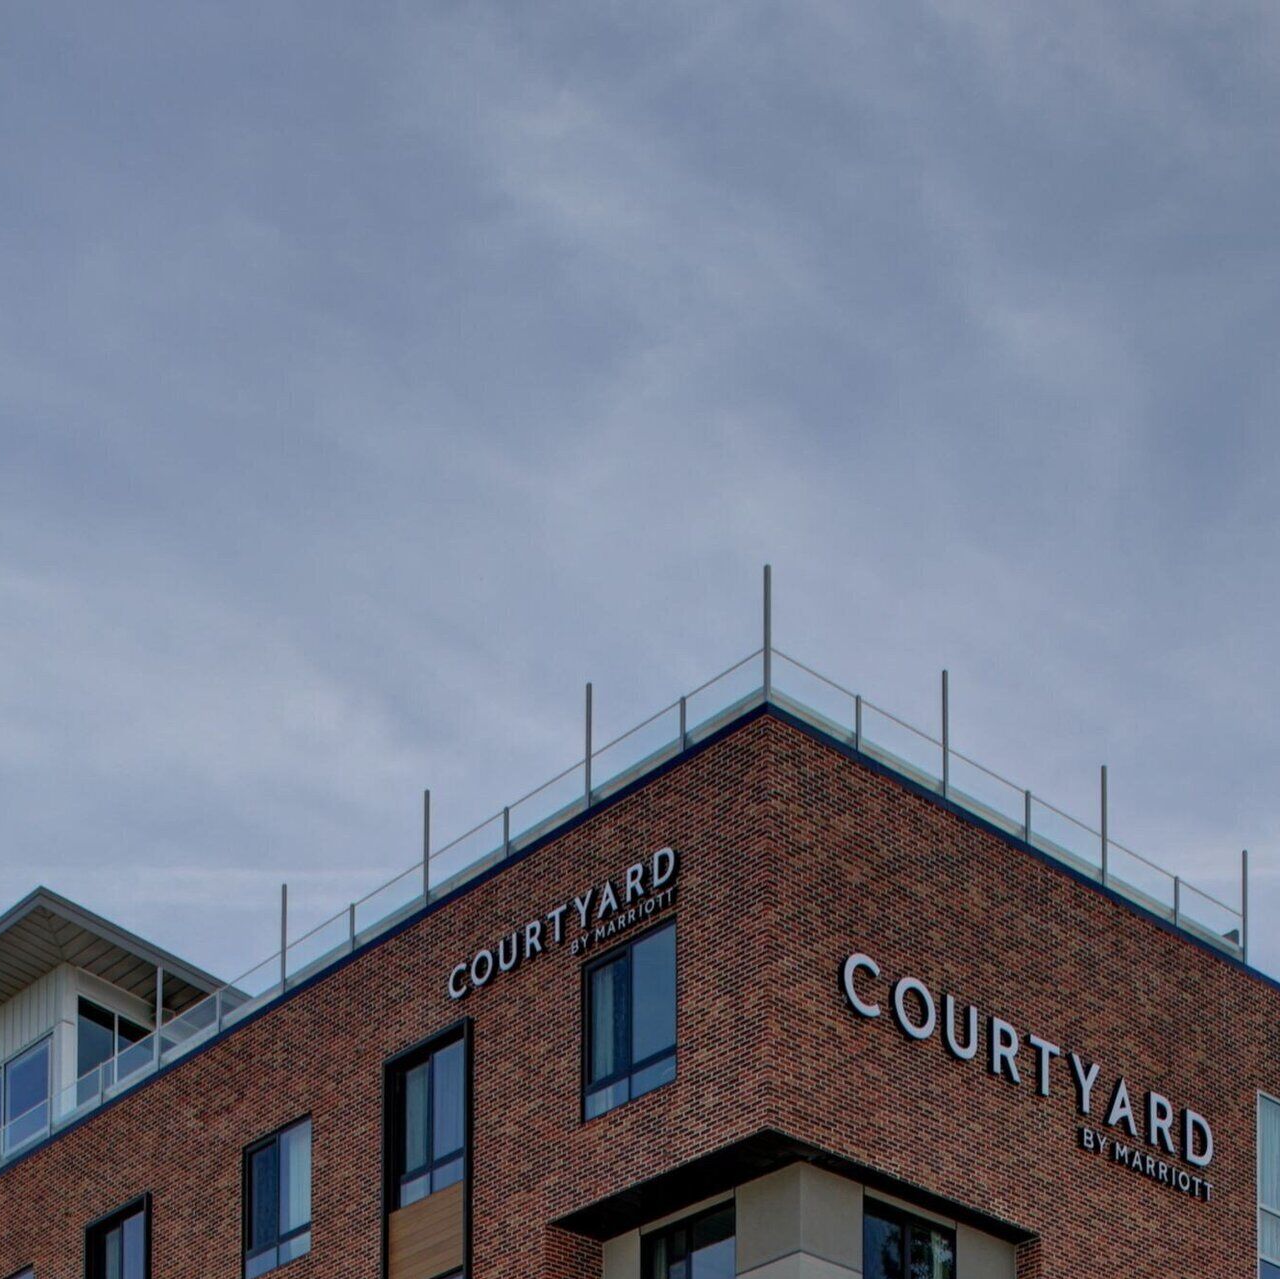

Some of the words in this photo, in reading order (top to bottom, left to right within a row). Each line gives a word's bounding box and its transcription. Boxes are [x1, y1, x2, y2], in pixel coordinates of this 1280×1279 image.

[448, 847, 676, 999] COURTYARD
[570, 933, 589, 955] BY
[595, 887, 674, 942] MARRIOTT
[843, 953, 1214, 1167] COURTYARD
[1083, 1127, 1107, 1154] BY
[1115, 1141, 1214, 1201] MARRIOTT
